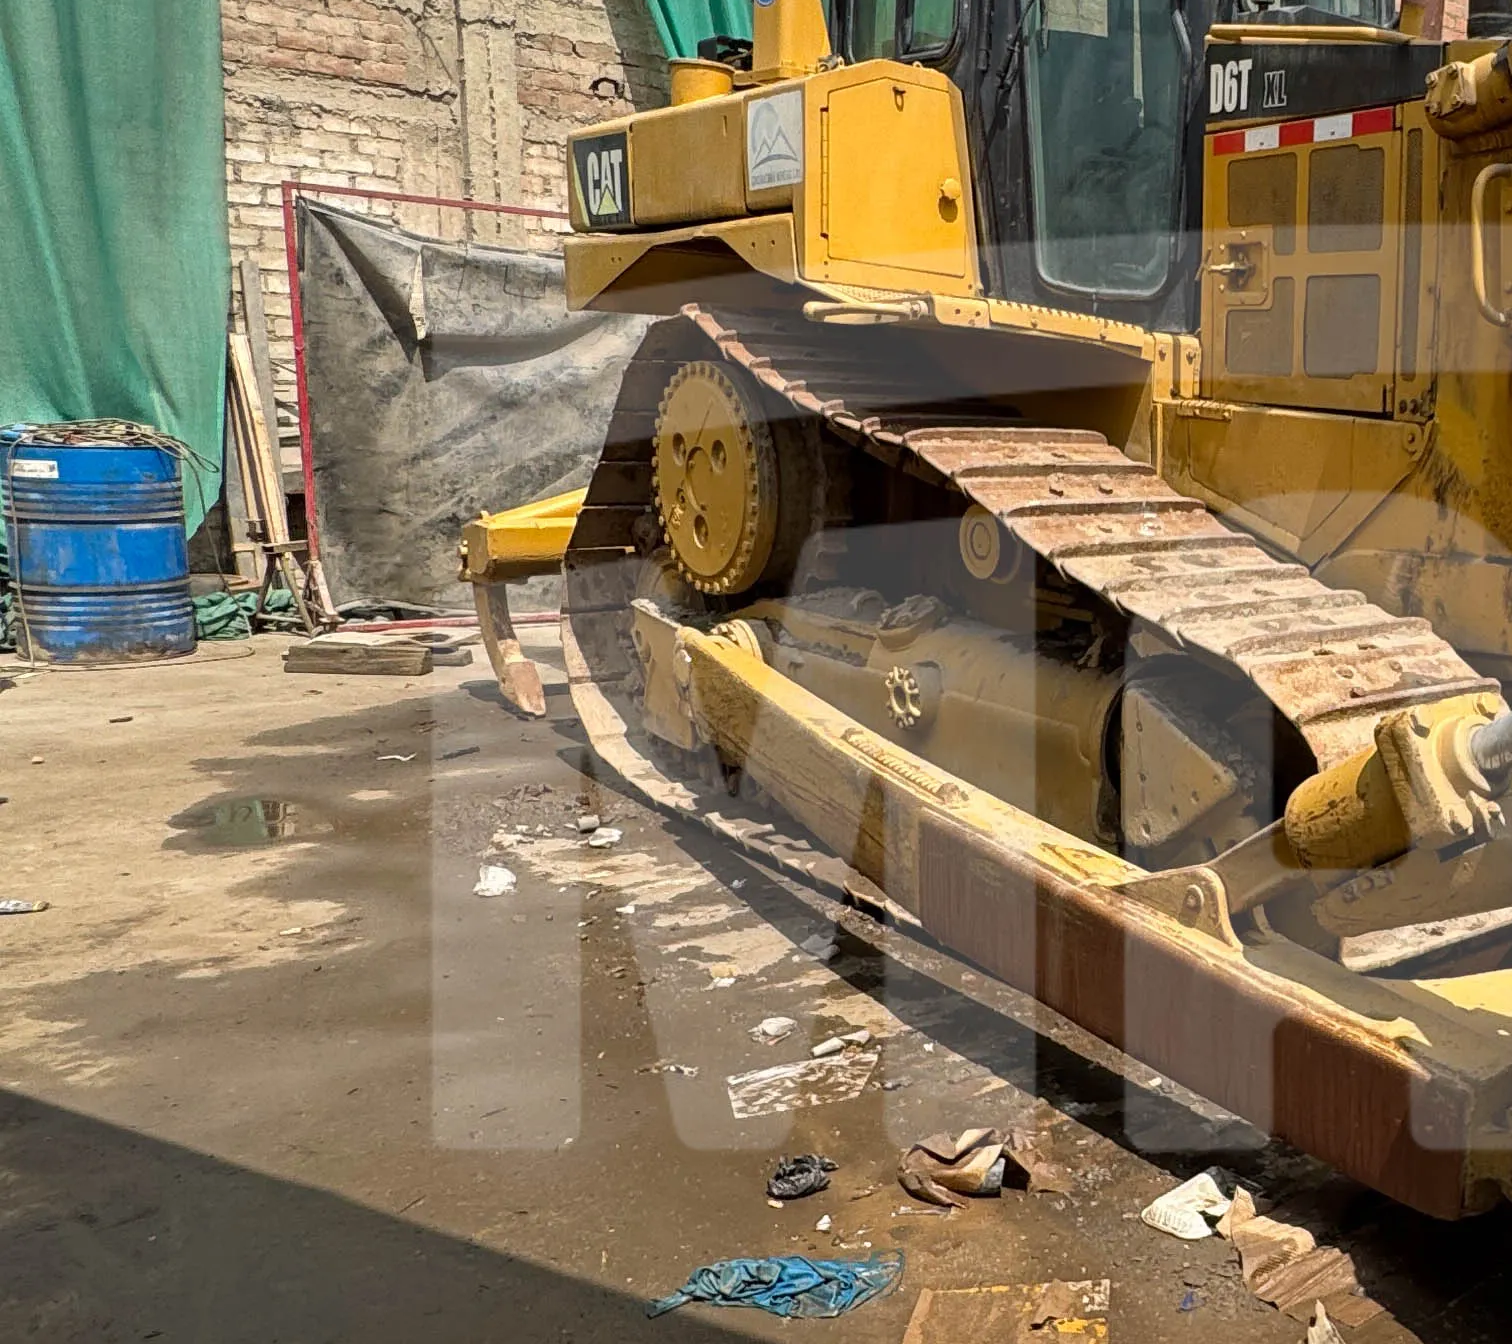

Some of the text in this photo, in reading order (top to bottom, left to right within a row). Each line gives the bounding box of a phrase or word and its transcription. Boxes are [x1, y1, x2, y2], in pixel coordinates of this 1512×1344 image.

[1209, 58, 1287, 114] D6T XL
[586, 148, 623, 215] CAT
